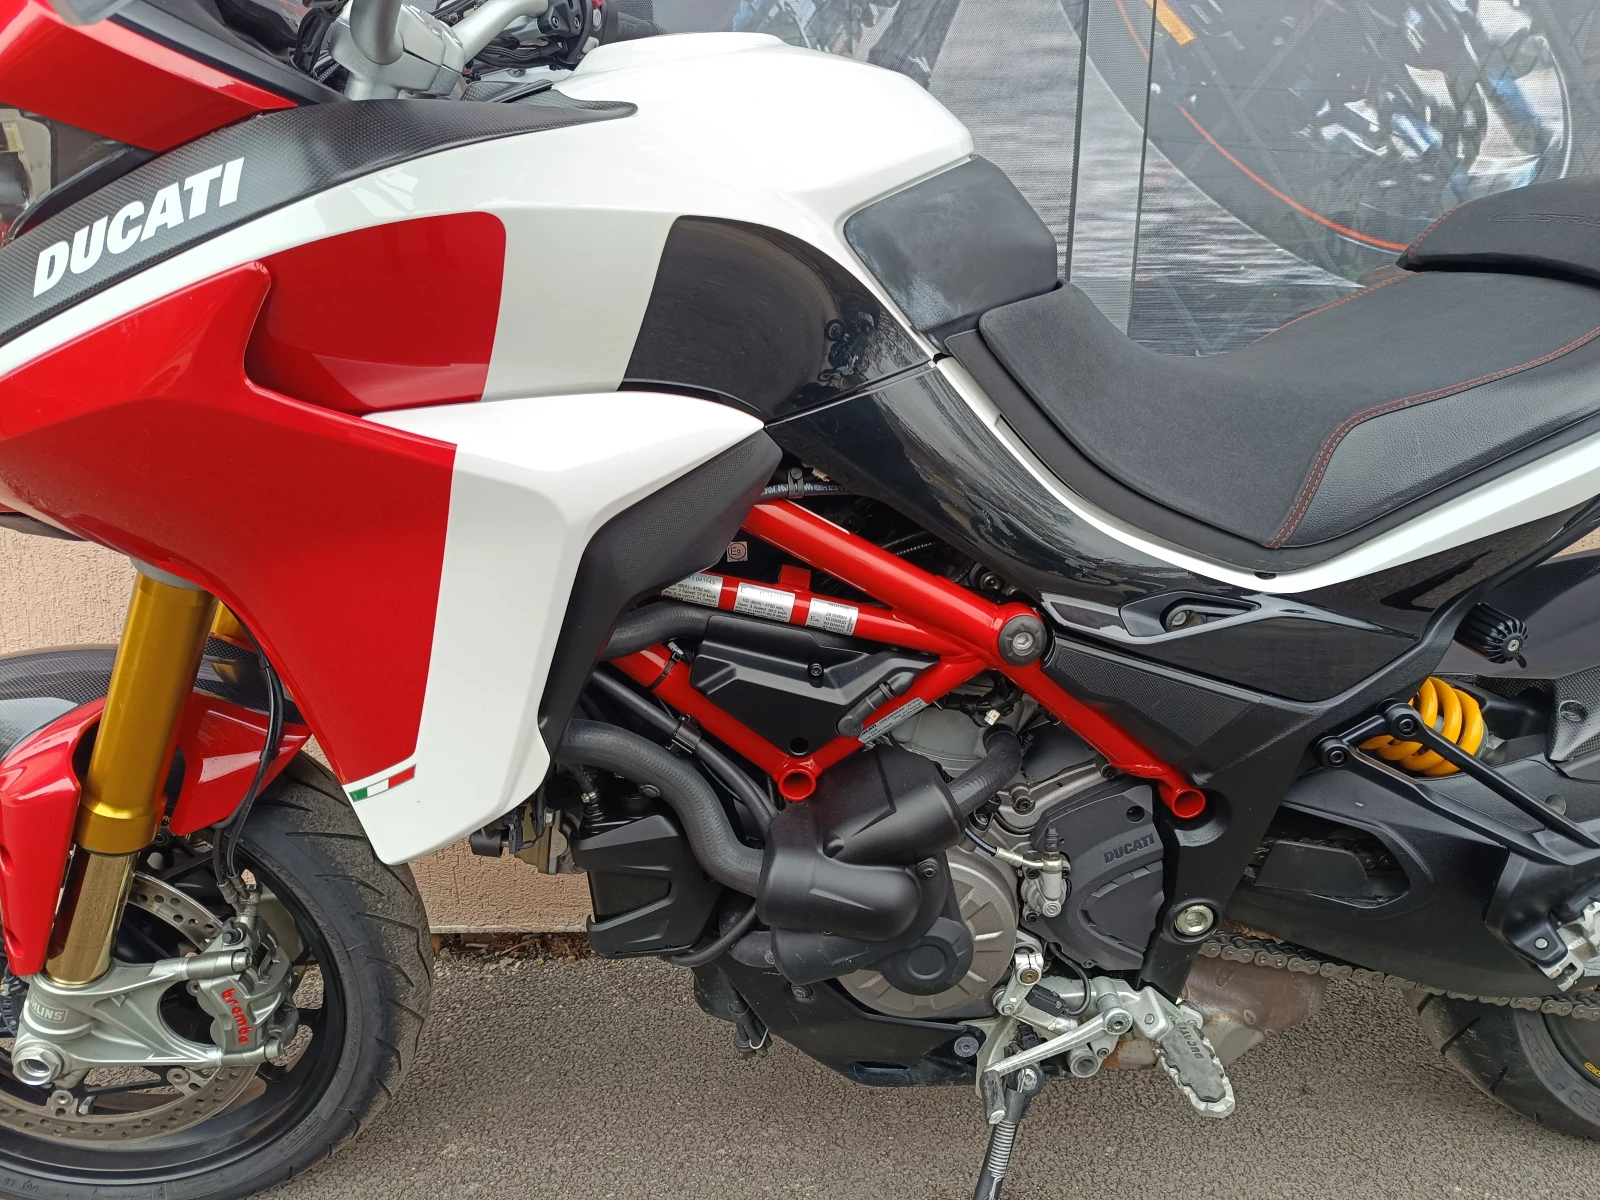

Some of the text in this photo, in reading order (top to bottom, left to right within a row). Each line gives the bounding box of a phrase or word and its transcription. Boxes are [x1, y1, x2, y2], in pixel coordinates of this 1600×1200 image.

[33, 157, 244, 297] DUCATI
[1104, 833, 1155, 864] DUCATI
[221, 988, 253, 1045] brembo
[1178, 1026, 1205, 1059] DUCATI
